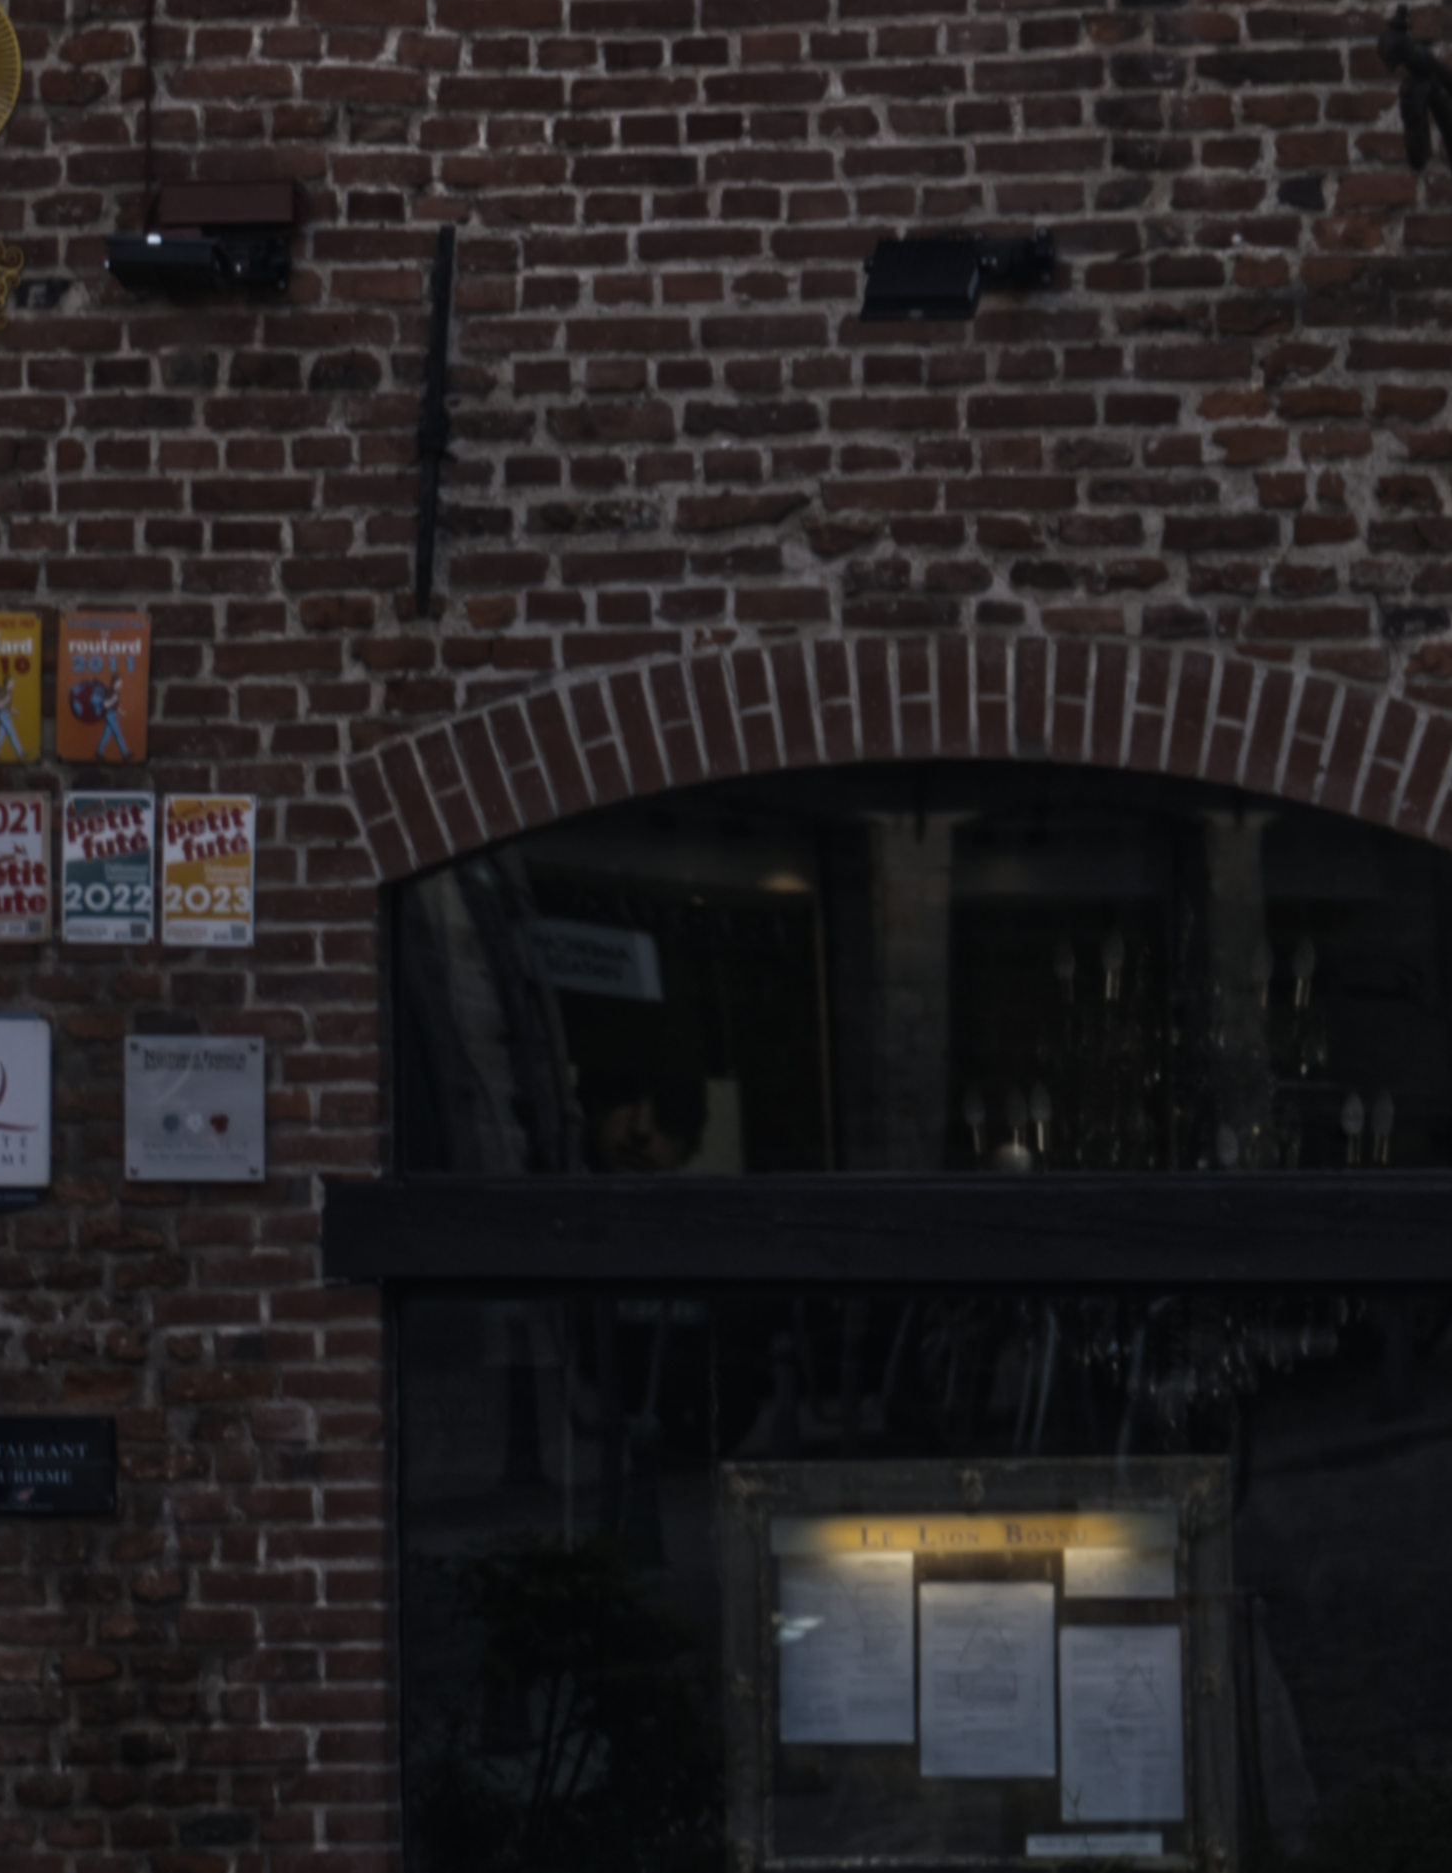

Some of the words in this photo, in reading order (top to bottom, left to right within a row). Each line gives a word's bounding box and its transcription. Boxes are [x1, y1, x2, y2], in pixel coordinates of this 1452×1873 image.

[67, 636, 143, 656] routard
[71, 655, 136, 673] 2011
[66, 803, 146, 843] petit
[167, 805, 247, 845] petit
[65, 881, 150, 914] 2022
[165, 883, 249, 915] 2023
